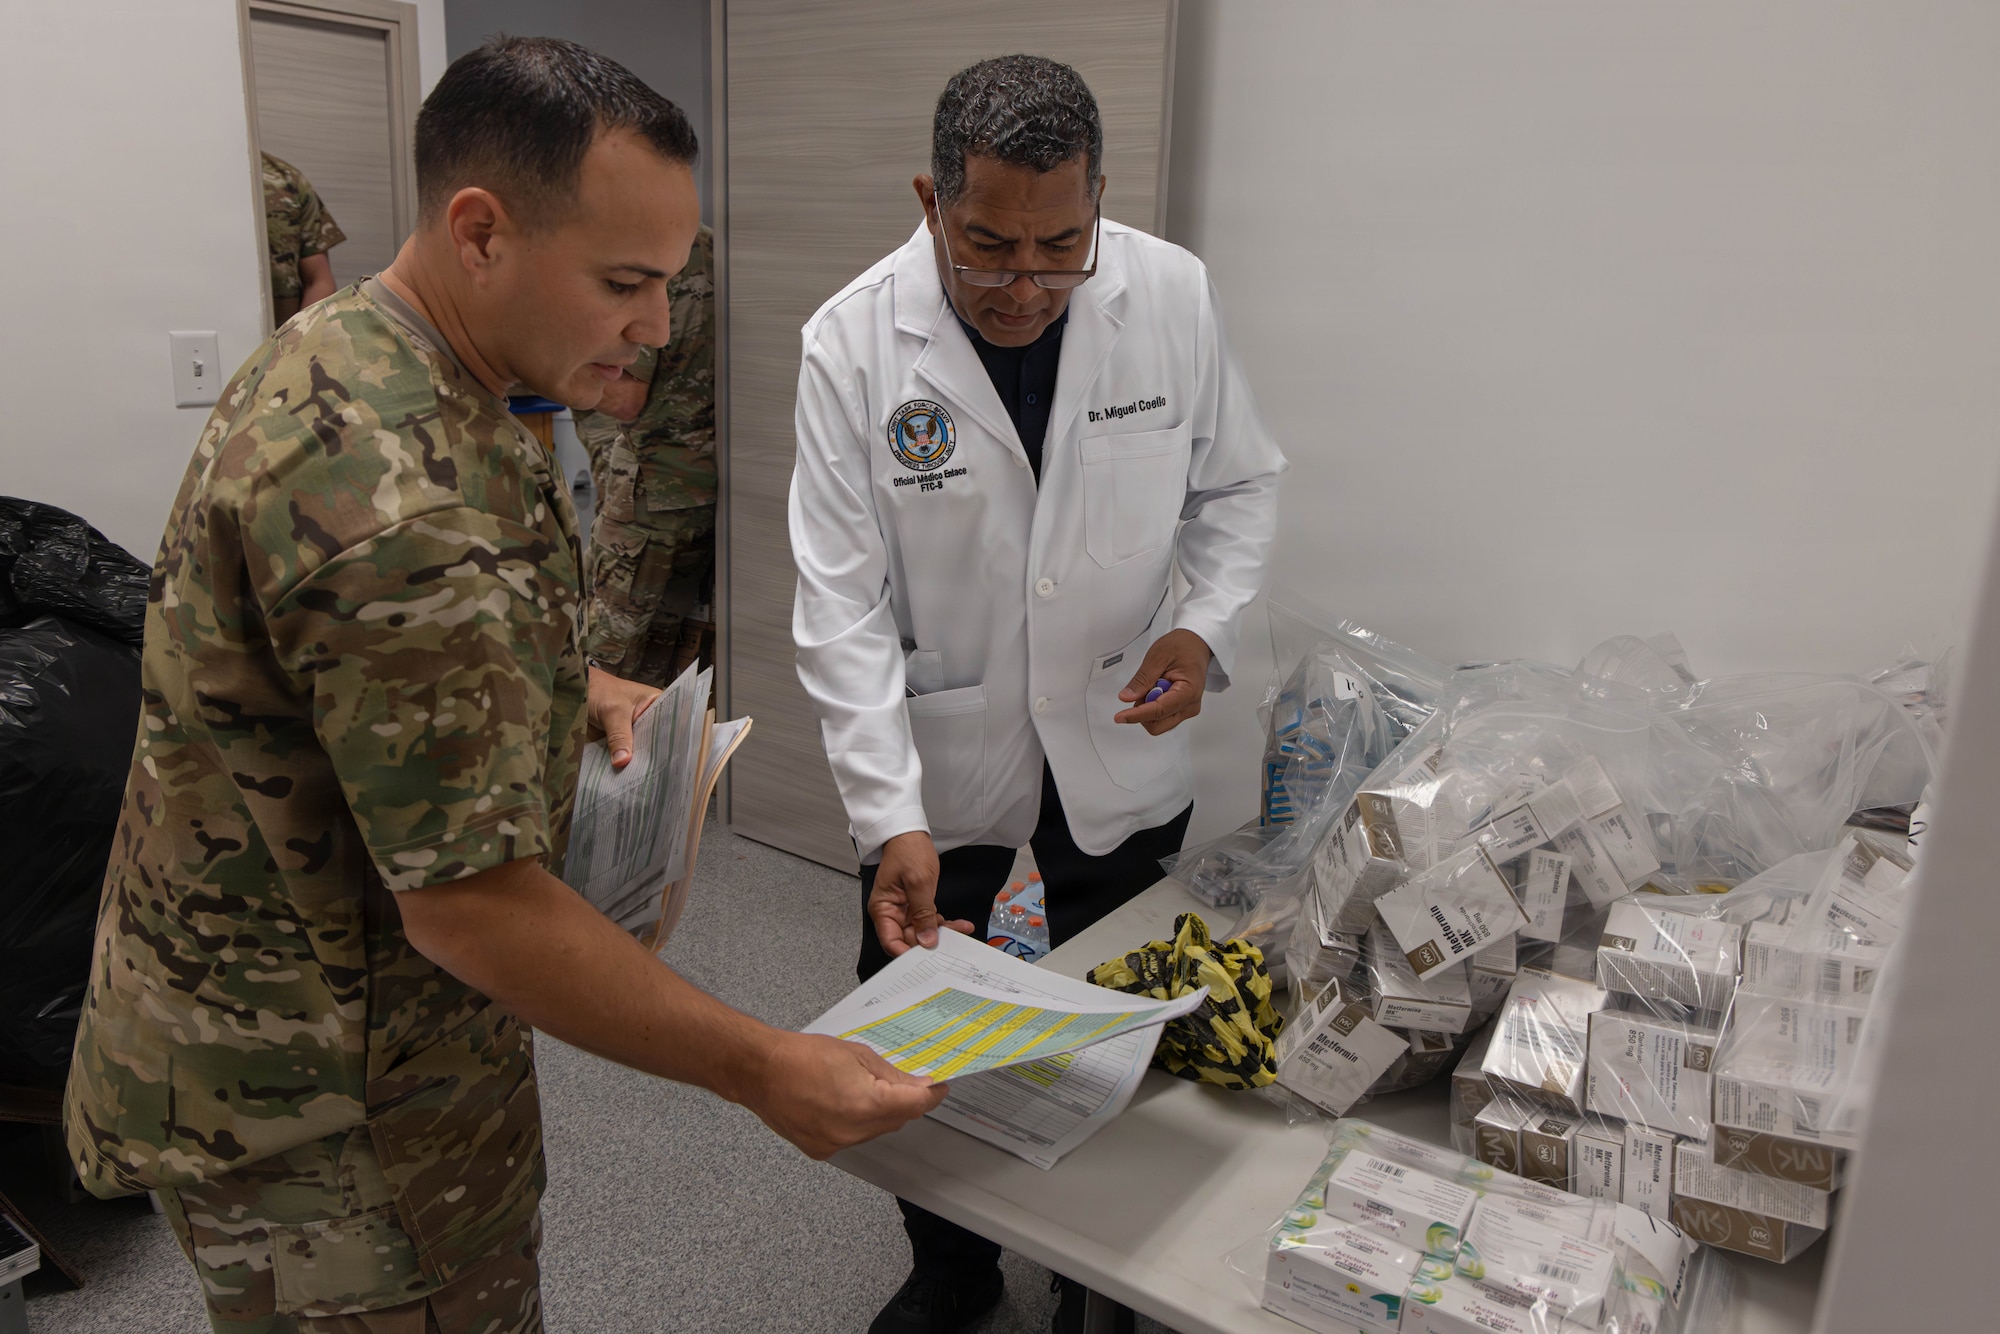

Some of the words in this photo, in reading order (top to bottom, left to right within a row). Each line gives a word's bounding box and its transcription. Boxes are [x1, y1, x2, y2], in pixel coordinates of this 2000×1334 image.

[1088, 411, 1104, 422] Dr.
[1104, 401, 1137, 419] Miguel
[1138, 395, 1166, 411] Coello
[893, 474, 916, 487] Oficial
[916, 472, 943, 484] Médico
[944, 467, 967, 478] Enlace
[1459, 906, 1483, 941] Hydrochloride
[1473, 912, 1484, 924] mg
[1430, 905, 1464, 955] Metformin
[1478, 924, 1491, 938] 850
[1420, 949, 1435, 964] MK
[1387, 1004, 1422, 1013] Metformina
[1338, 1018, 1352, 1028] MK
[1628, 1029, 1637, 1044] 850
[1316, 1033, 1358, 1063] Metformin
[1626, 1045, 1634, 1057] mg
[1298, 1055, 1309, 1065] 850
[1309, 1061, 1320, 1072] mg
[1697, 1051, 1706, 1067] MK
[1730, 1138, 1747, 1151] MK
[1541, 1147, 1549, 1160] MK
[1776, 1147, 1825, 1171] MK
[1604, 1150, 1613, 1187] Metformina
[1353, 1201, 1386, 1220] Tabletas
[1679, 1206, 1728, 1238] MK
[1334, 1230, 1352, 1240] USP
[1354, 1238, 1389, 1256] Tabletas
[1346, 1230, 1383, 1247] Aciclovir
[1752, 1230, 1769, 1241] MK
[1323, 1250, 1342, 1260] USP
[1344, 1259, 1379, 1277] Tabletas
[1336, 1250, 1373, 1268] Aciclovir
[1517, 1282, 1558, 1299] Aciclir
[1463, 1306, 1482, 1316] USP
